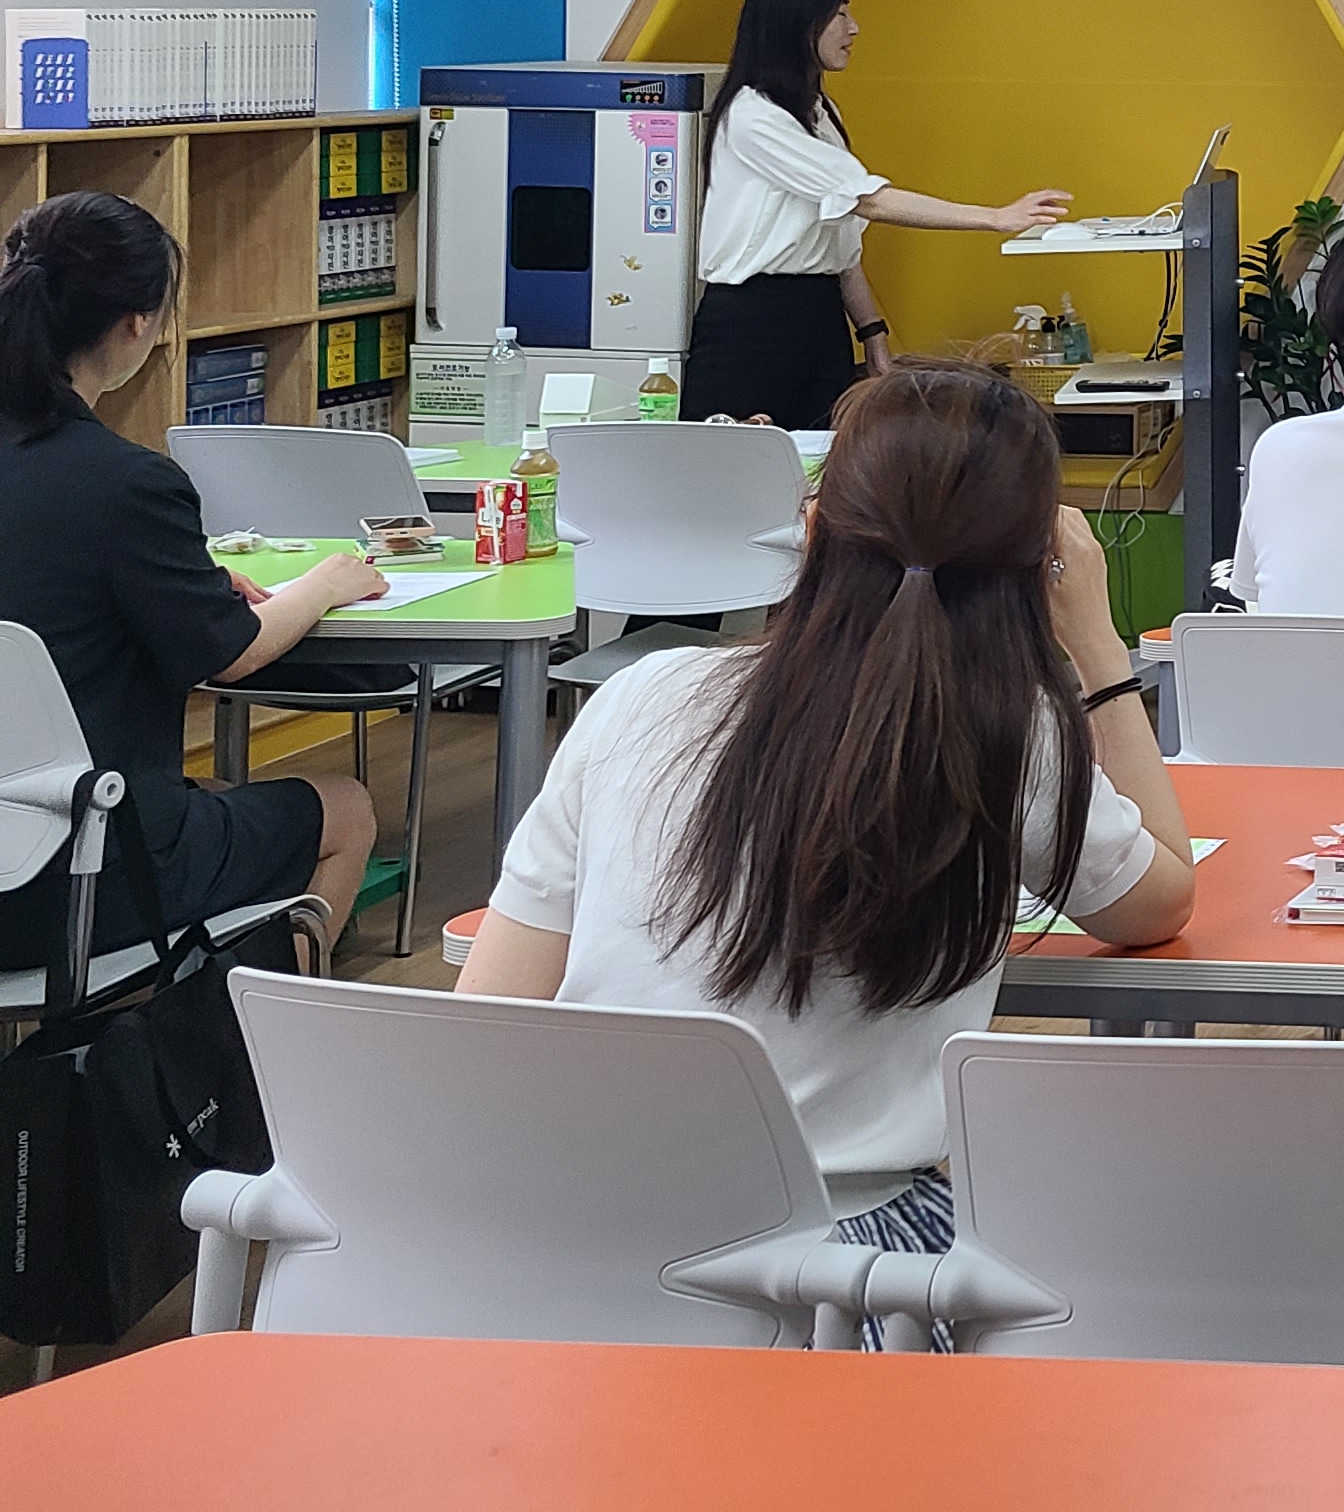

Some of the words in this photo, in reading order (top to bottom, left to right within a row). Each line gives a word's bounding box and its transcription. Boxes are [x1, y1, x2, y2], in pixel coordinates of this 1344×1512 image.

[17, 1130, 29, 1177] OUTDOOR
[16, 1178, 28, 1226] LIFESTYLE
[15, 1229, 26, 1273] CREATOR
